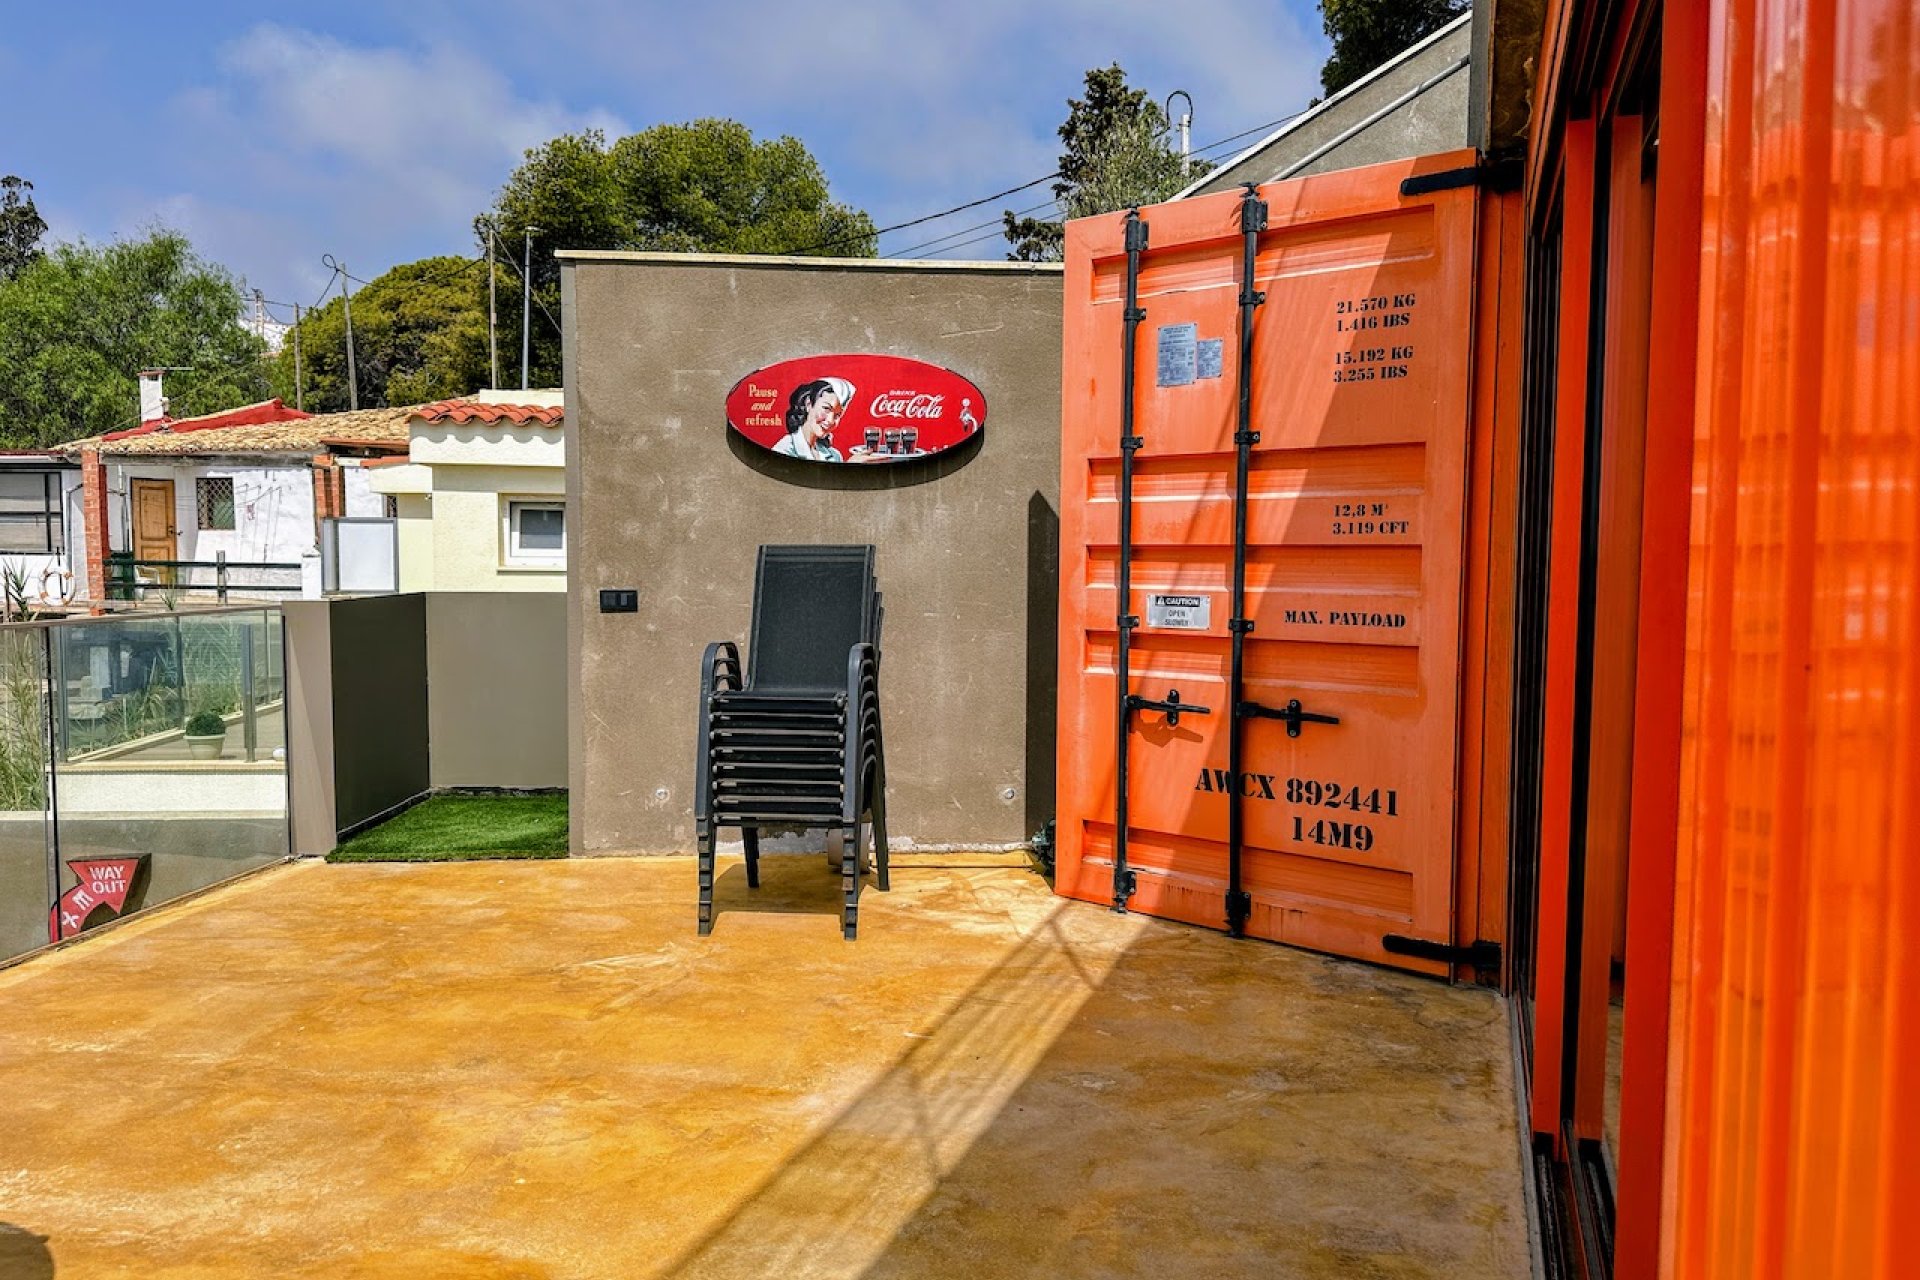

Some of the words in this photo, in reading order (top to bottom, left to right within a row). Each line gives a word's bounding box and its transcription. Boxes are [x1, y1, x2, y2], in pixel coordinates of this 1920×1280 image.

[1337, 297, 1387, 313] 21.570
[1394, 293, 1415, 307] KG
[1337, 317, 1377, 331] 1.416
[1336, 348, 1385, 364] 15.192
[1392, 346, 1413, 359] KG
[1334, 368, 1374, 382] 3.255
[748, 384, 778, 398] Pause
[751, 400, 773, 412] and
[871, 394, 945, 418] Coca-Cola
[745, 416, 782, 428] refresh
[1333, 522, 1374, 535] 3.119
[1379, 521, 1409, 534] CFT
[1166, 597, 1199, 606] CAUTION
[1284, 610, 1323, 625] MAX.
[1330, 612, 1406, 628] PAYLOAD
[1286, 778, 1398, 816] 892441
[1292, 816, 1374, 851] 14M9
[89, 866, 124, 880] WAY
[92, 880, 126, 894] OUT
